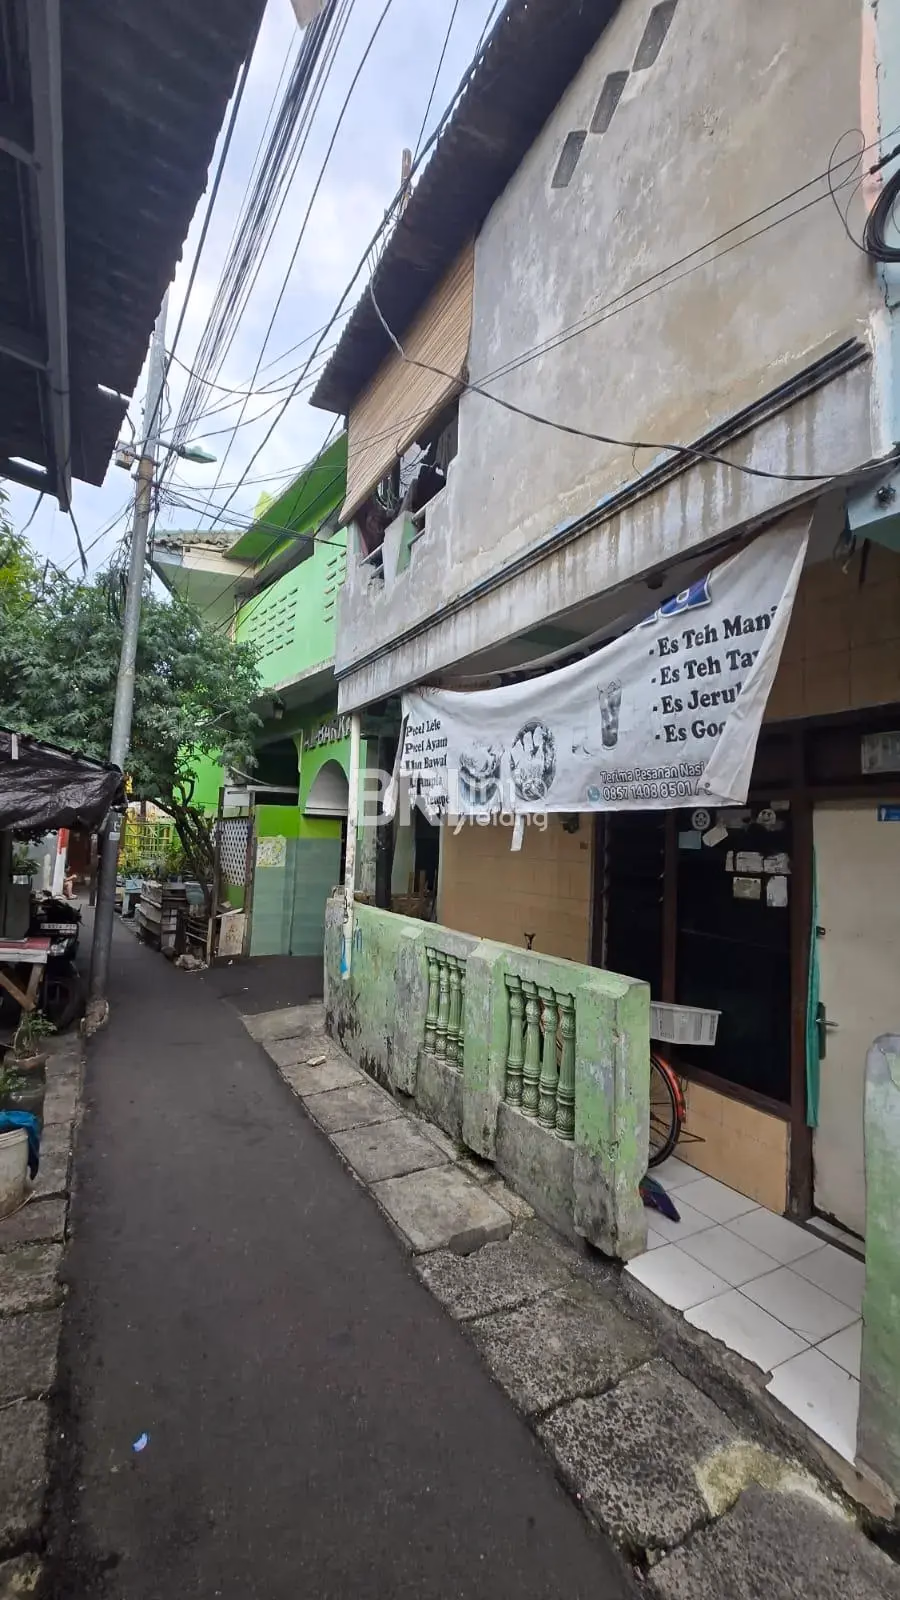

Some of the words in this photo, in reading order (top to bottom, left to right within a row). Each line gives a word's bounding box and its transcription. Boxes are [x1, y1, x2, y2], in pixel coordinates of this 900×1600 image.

[657, 636, 679, 657] Es
[682, 624, 719, 649] Teh
[660, 665, 680, 685] Es
[684, 656, 722, 680] Teh
[661, 695, 683, 714] Es
[426, 719, 441, 732] Lele
[664, 724, 687, 743] Es
[426, 737, 448, 752] Ayam
[424, 753, 448, 769] Bawal
[600, 769, 633, 785] Terima
[634, 765, 678, 781] Pesanan
[680, 761, 705, 777] Nasi
[603, 785, 629, 801] 0857
[631, 783, 658, 800] 1408
[660, 780, 692, 798] 8501
